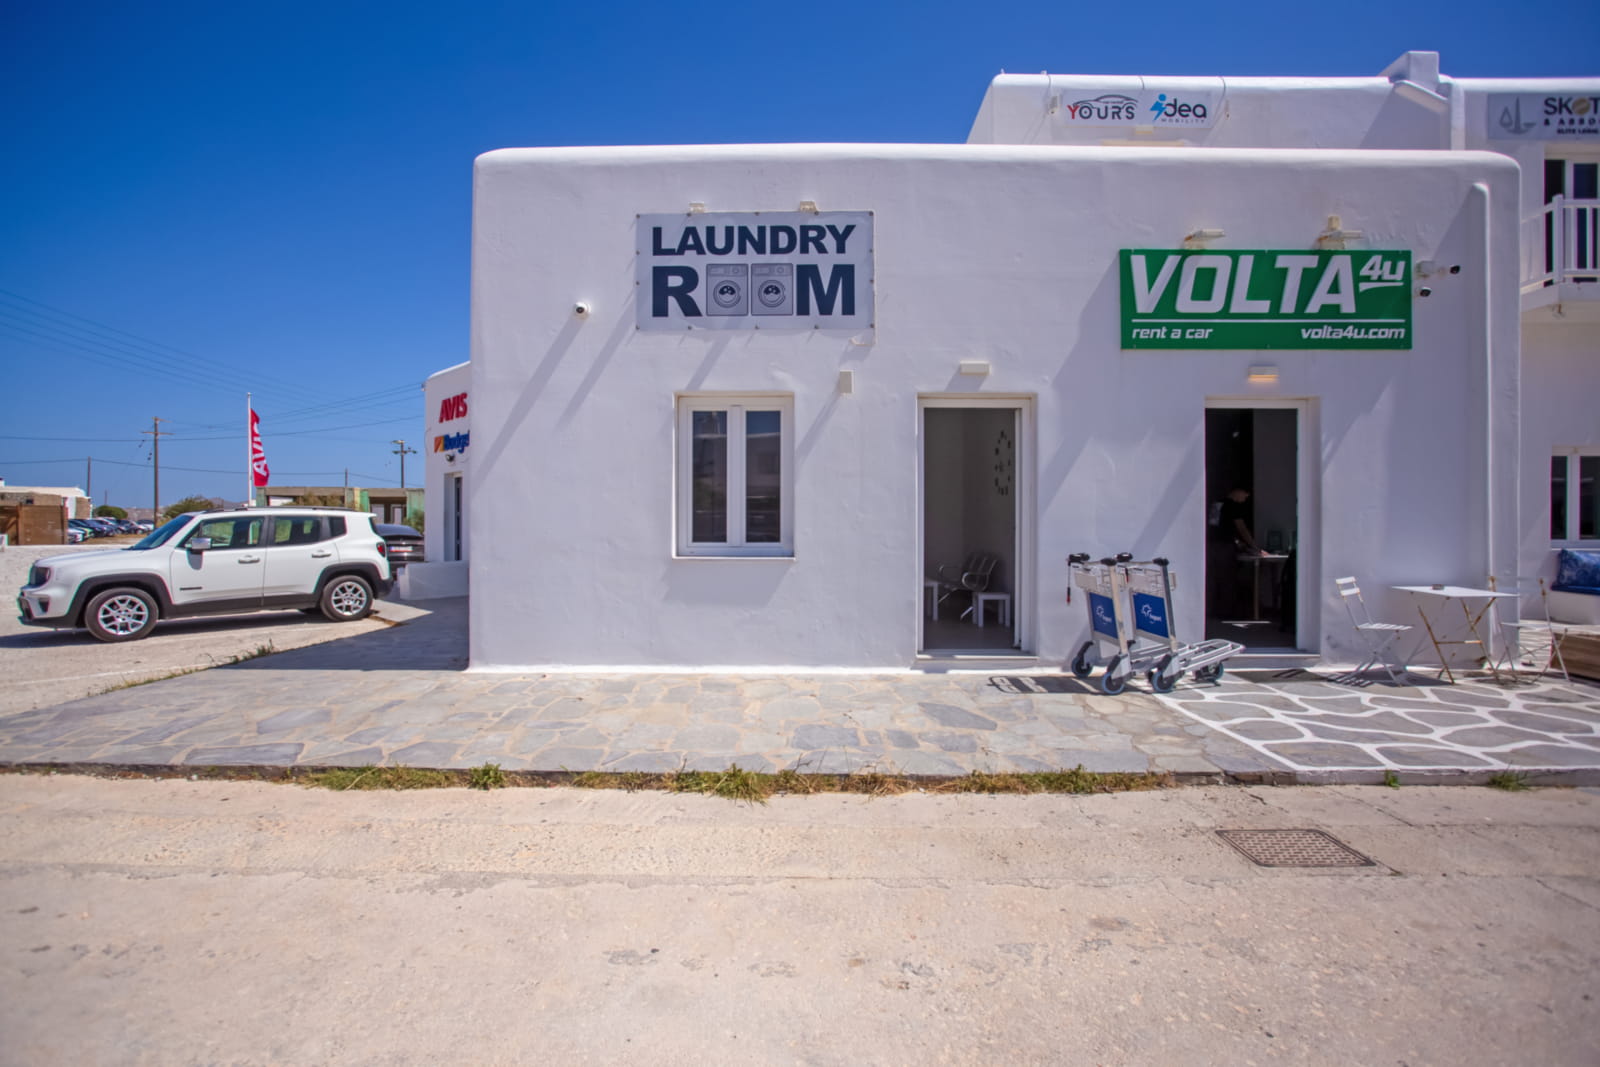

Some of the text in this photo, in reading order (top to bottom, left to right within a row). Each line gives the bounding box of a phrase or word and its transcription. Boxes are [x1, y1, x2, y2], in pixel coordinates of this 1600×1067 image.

[1066, 104, 1135, 120] YOURS
[652, 224, 857, 256] LAUNDRY
[1130, 254, 1356, 314] VOLTA
[1132, 326, 1213, 339] rent a car
[1301, 325, 1405, 339] volta4u.com
[438, 392, 468, 423] AVIS
